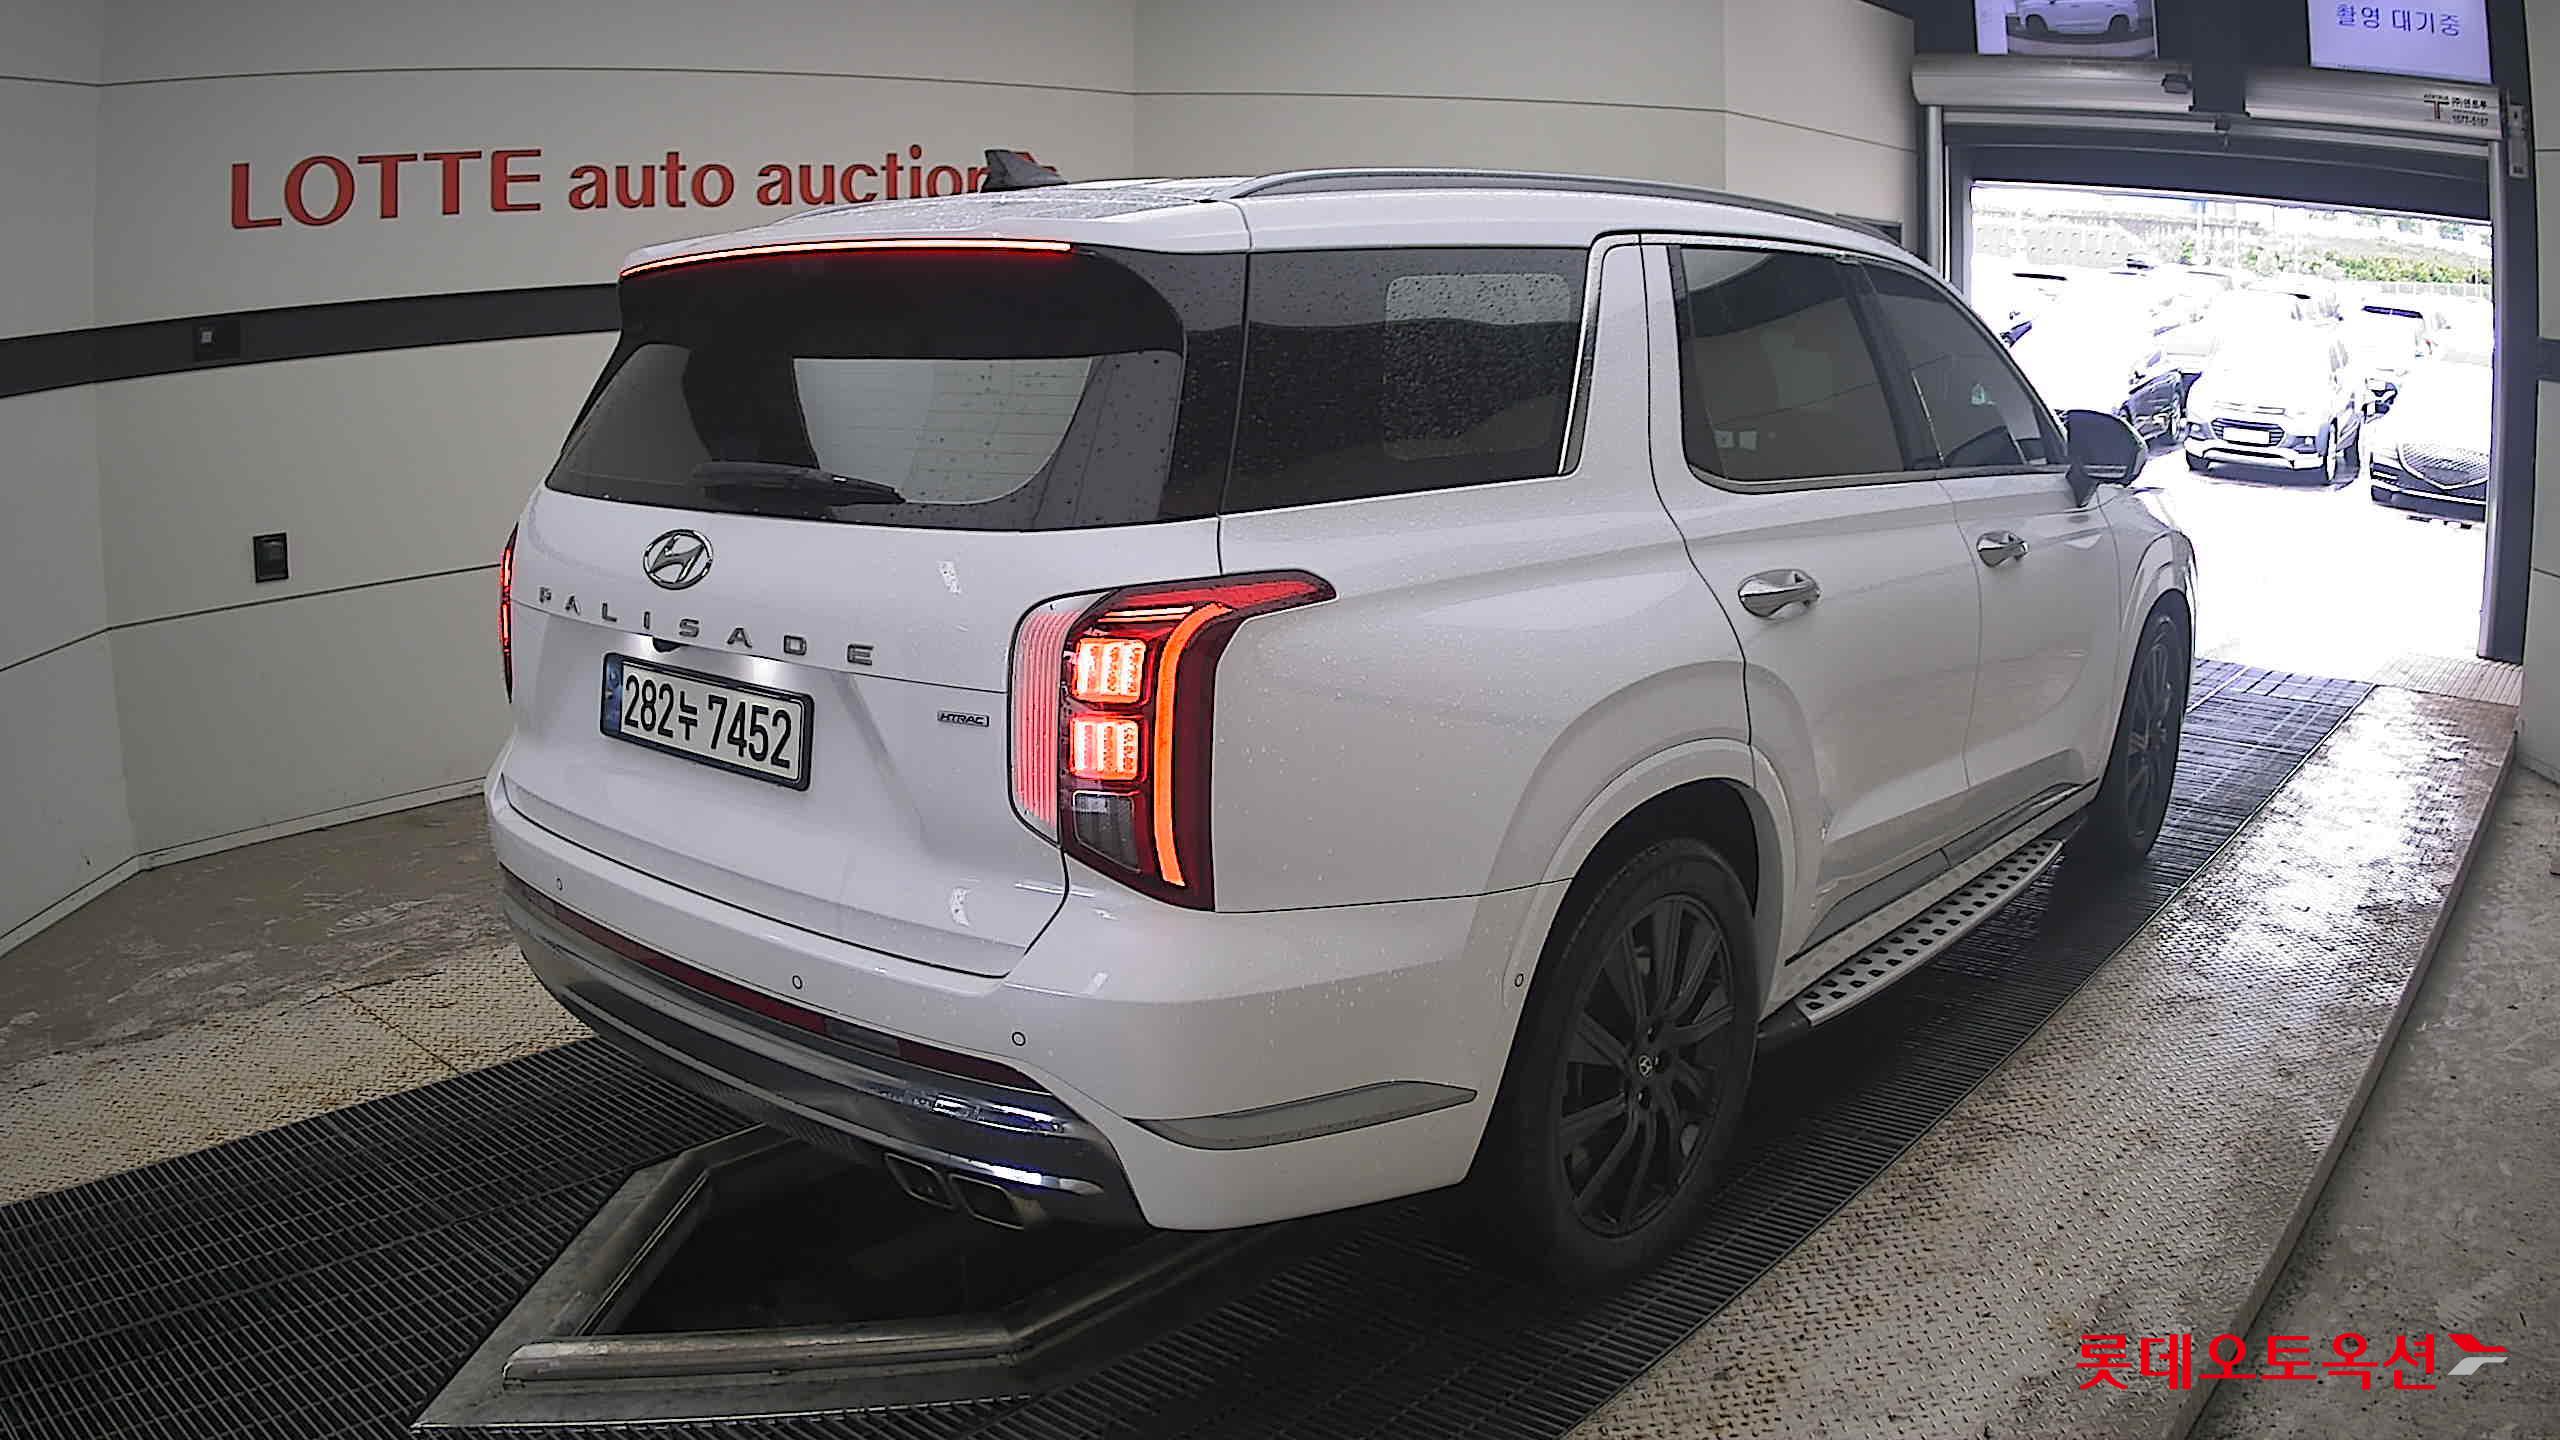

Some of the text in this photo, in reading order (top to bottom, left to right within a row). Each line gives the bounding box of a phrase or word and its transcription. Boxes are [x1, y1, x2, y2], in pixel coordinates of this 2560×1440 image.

[2337, 4, 2460, 37] 촬영 대기중
[231, 149, 542, 229] LOTTE
[568, 151, 735, 210] auto
[539, 586, 874, 667] PALISADE
[624, 674, 792, 769] 282누 7452
[940, 712, 985, 725] HTRAC
